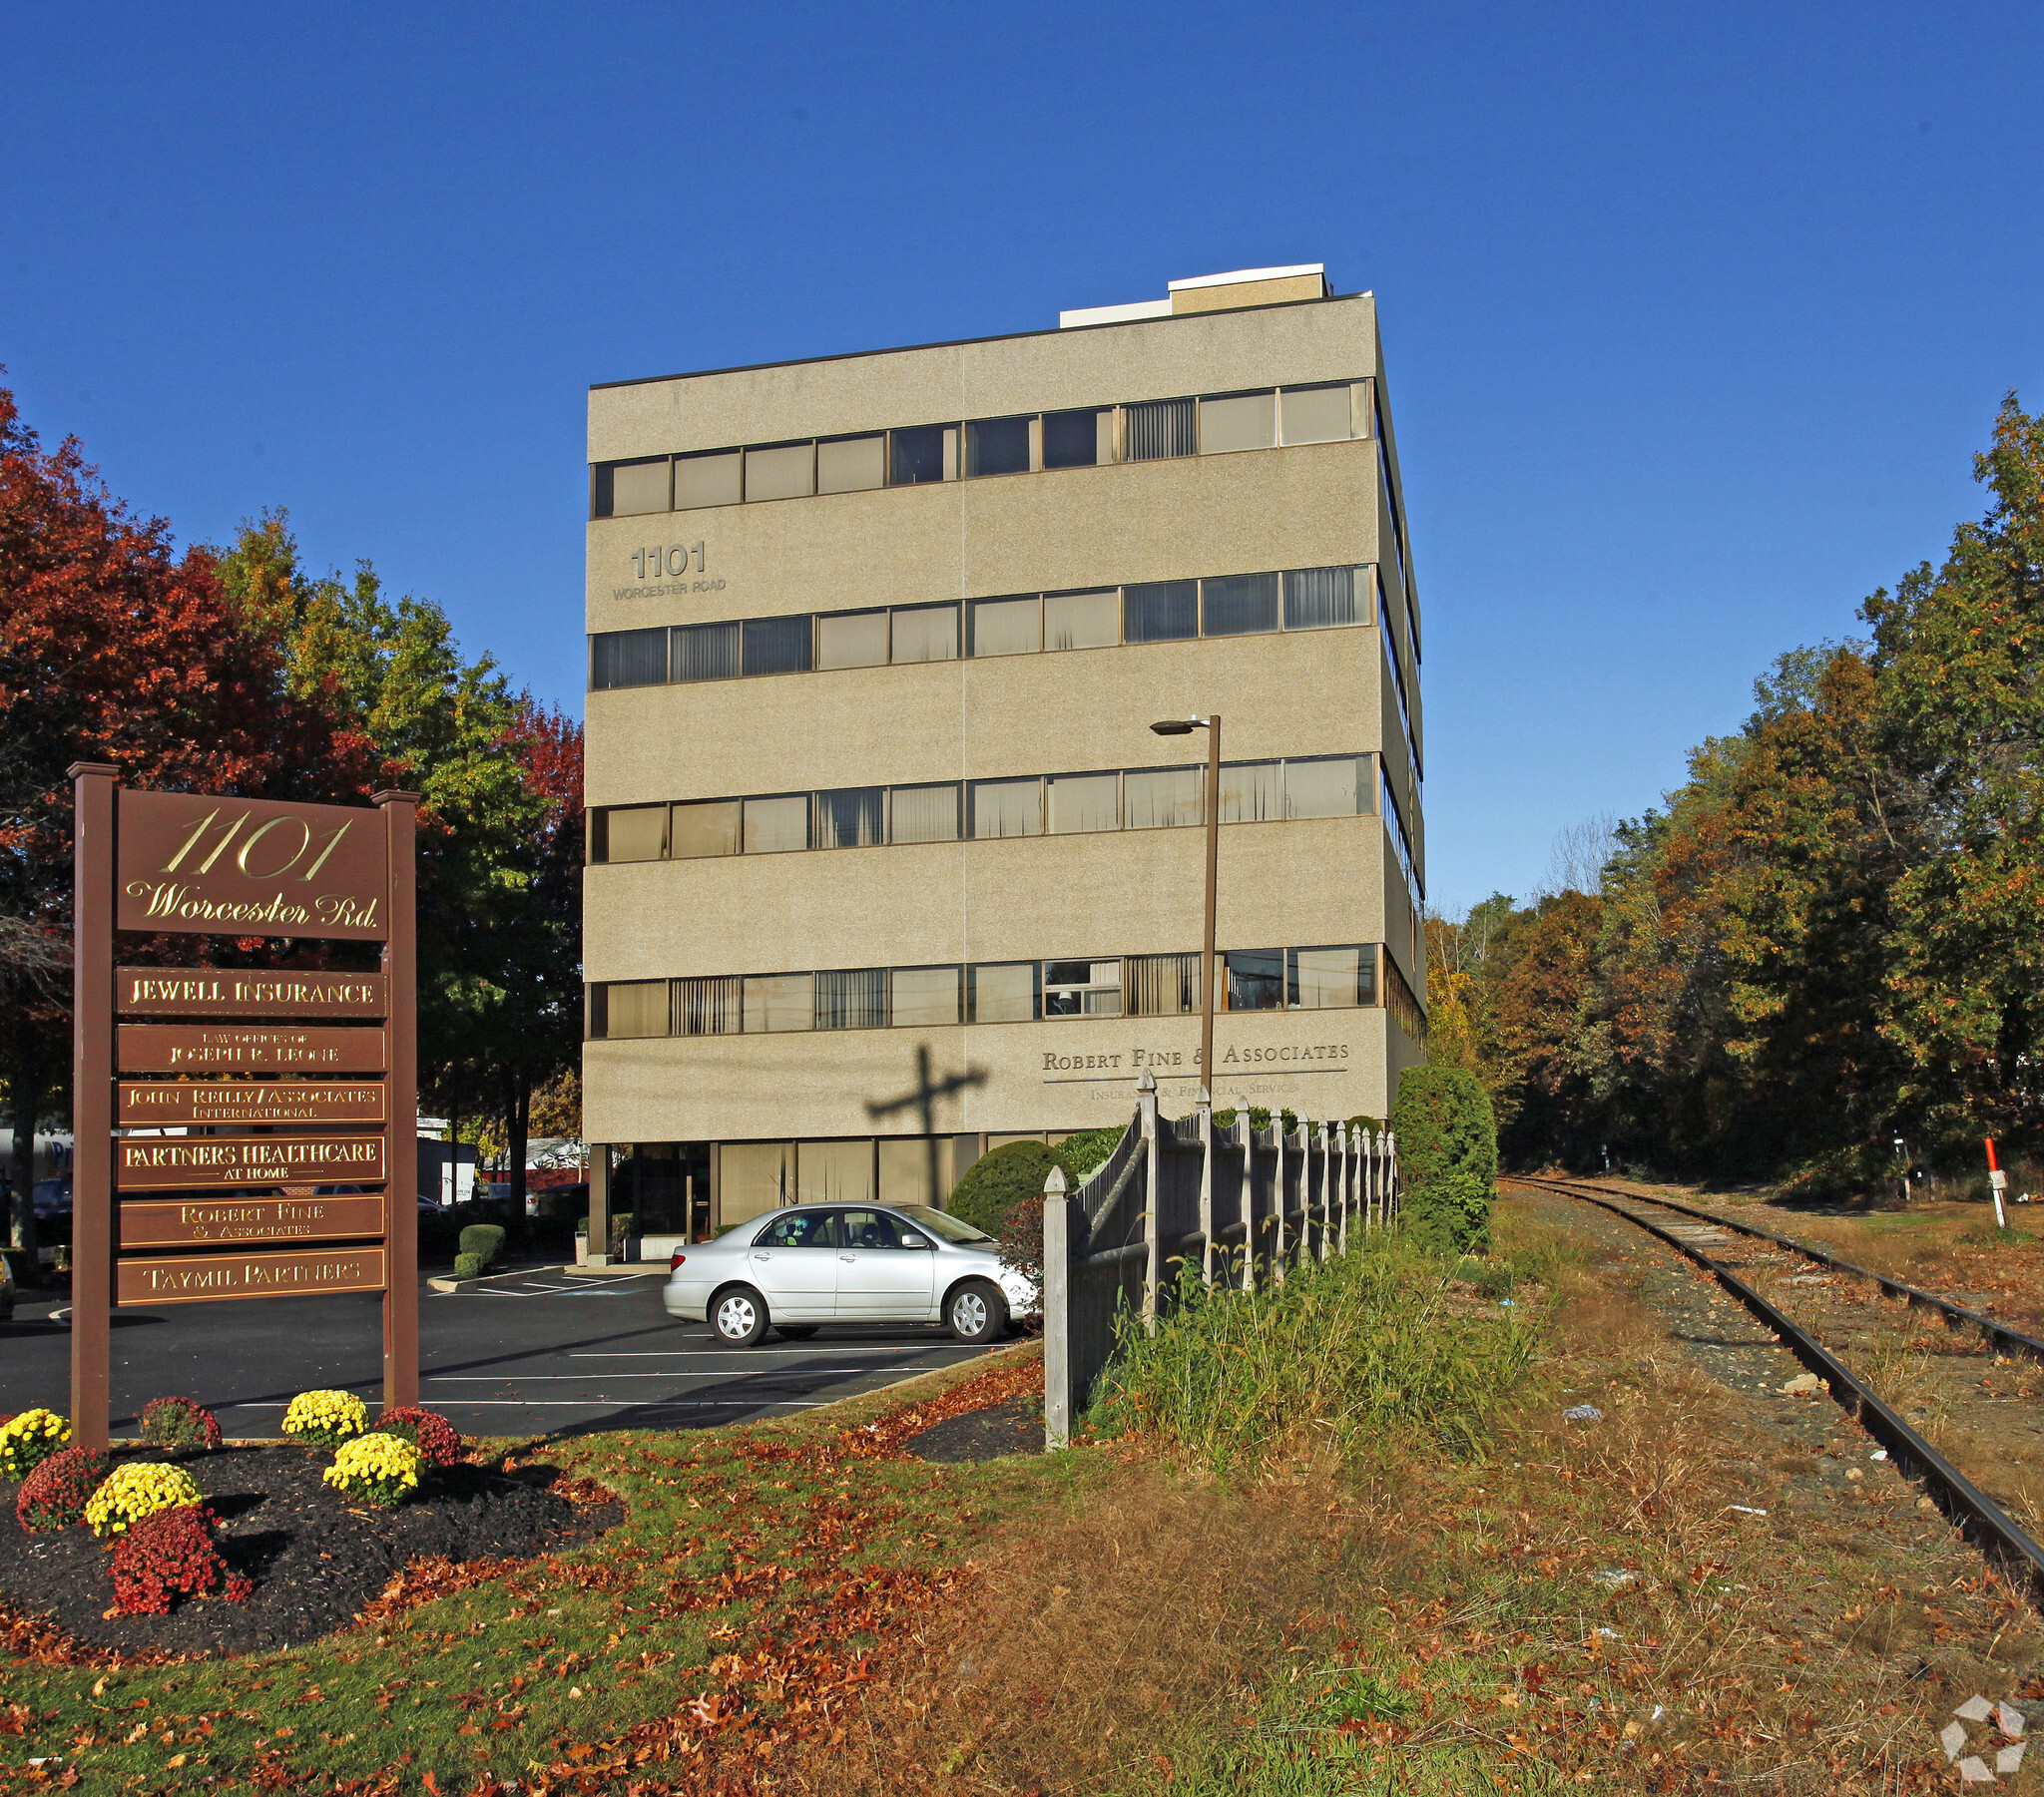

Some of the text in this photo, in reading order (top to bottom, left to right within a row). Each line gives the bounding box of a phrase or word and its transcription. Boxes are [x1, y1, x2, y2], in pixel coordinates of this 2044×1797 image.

[631, 541, 705, 579] 1101
[612, 579, 727, 601] WORCESTER ROAD
[158, 807, 353, 881] 1101
[126, 881, 378, 928] Worcester Rd.
[130, 980, 374, 1004] JEWELL INSURANCE
[203, 1033, 308, 1044] LAW OFFICES OF
[169, 1047, 243, 1065] JOSEPH
[276, 1048, 340, 1062] LEONE
[1042, 1052, 1122, 1071] ROBERT
[1132, 1049, 1183, 1068] FINE
[1222, 1044, 1350, 1064] ASSOCIATES
[128, 1090, 181, 1108] JOHN
[193, 1107, 318, 1119] INTERNATIONAL
[124, 1143, 377, 1167] PARTNERS HEALTHCARE
[224, 1167, 289, 1180] AT HOME
[181, 1203, 324, 1224] ROBERT FINE
[193, 1224, 311, 1239] & ASSOCIATES
[143, 1262, 361, 1290] TAYMIL PARTNERS
